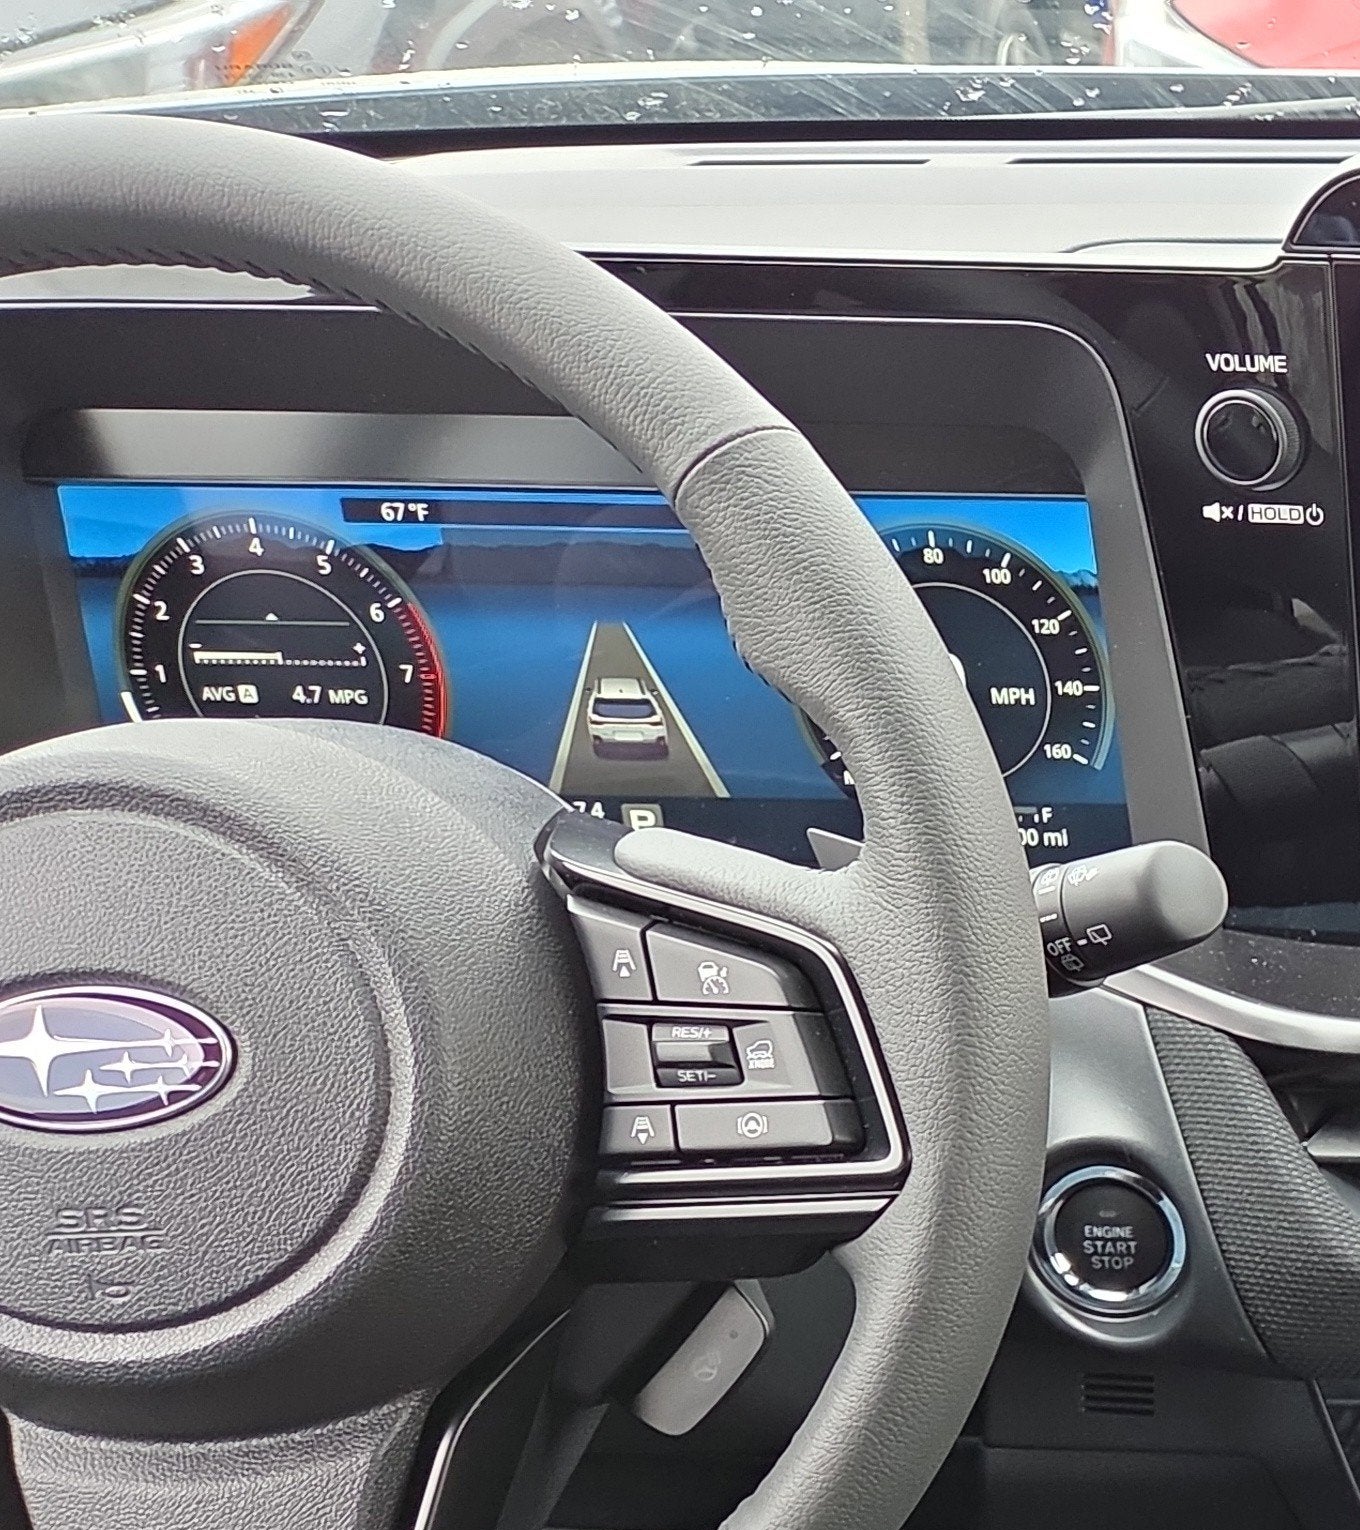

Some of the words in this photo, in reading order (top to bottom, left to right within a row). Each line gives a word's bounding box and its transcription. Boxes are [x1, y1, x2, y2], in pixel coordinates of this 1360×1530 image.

[1205, 353, 1288, 373] VOLUME
[380, 503, 429, 521] 67°F
[1250, 505, 1302, 522] HOLD
[249, 538, 263, 556] 4
[923, 548, 943, 564] 80
[189, 555, 204, 574] 3
[317, 555, 331, 574] 5
[983, 568, 1011, 584] 100
[154, 601, 169, 620] 2
[370, 603, 385, 621] 6
[1031, 618, 1060, 634] 120
[155, 665, 166, 683] 1
[400, 664, 413, 682] 7
[202, 686, 236, 702] AVG
[292, 686, 322, 704] 4.7
[329, 689, 368, 705] MPG
[990, 687, 1035, 705] MPH
[1055, 680, 1082, 696] 140
[1044, 744, 1071, 759] 160
[1041, 807, 1053, 823] F
[1047, 936, 1072, 957] OFF
[55, 1207, 149, 1231] SRS
[1084, 1224, 1134, 1239] ENGINE
[1082, 1240, 1138, 1255] START
[1090, 1255, 1135, 1270] STOP
